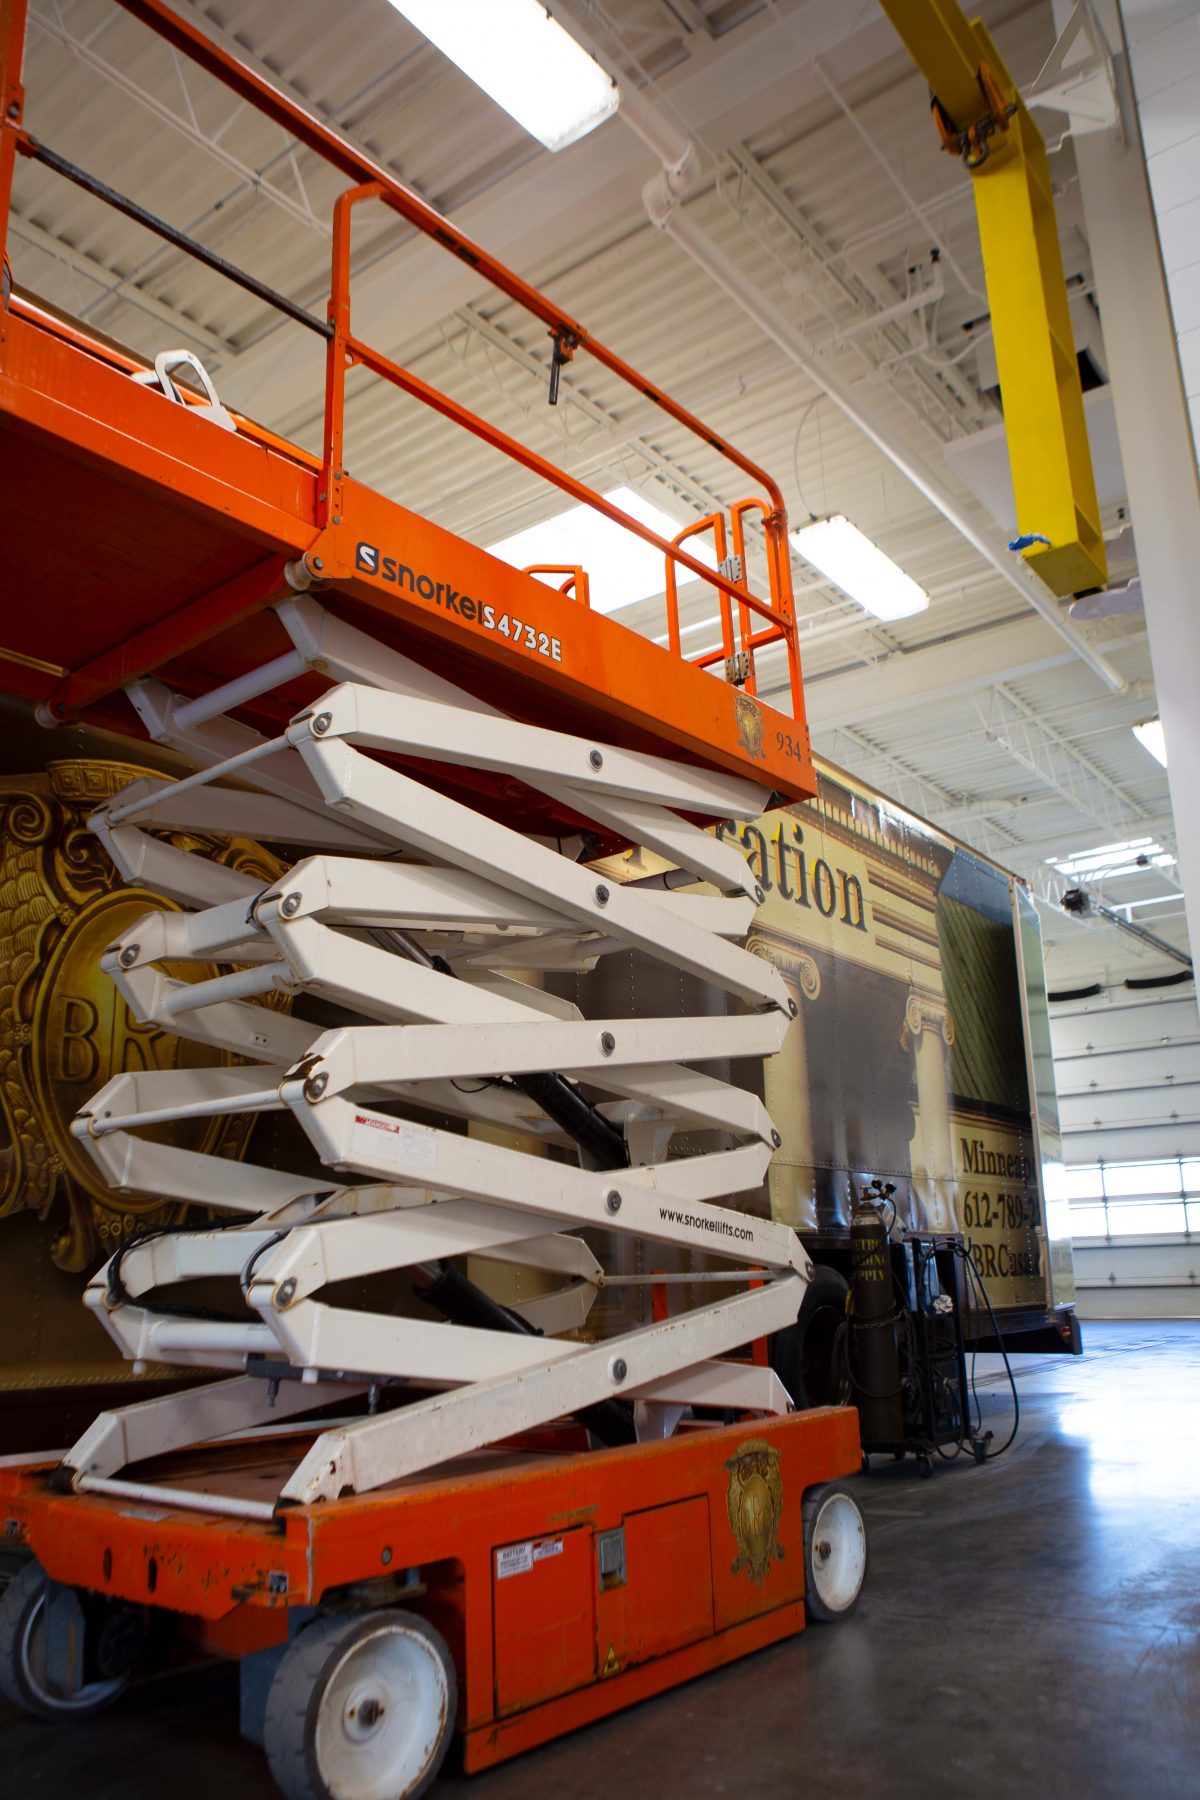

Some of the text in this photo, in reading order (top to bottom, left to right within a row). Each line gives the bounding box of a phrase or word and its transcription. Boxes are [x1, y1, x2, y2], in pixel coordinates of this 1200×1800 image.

[382, 557, 483, 625] snorkel
[482, 604, 562, 662] S4732E
[776, 732, 802, 762] 934
[659, 1207, 754, 1242] www.snorkellifts.com
[503, 1547, 526, 1559] BATTERY
